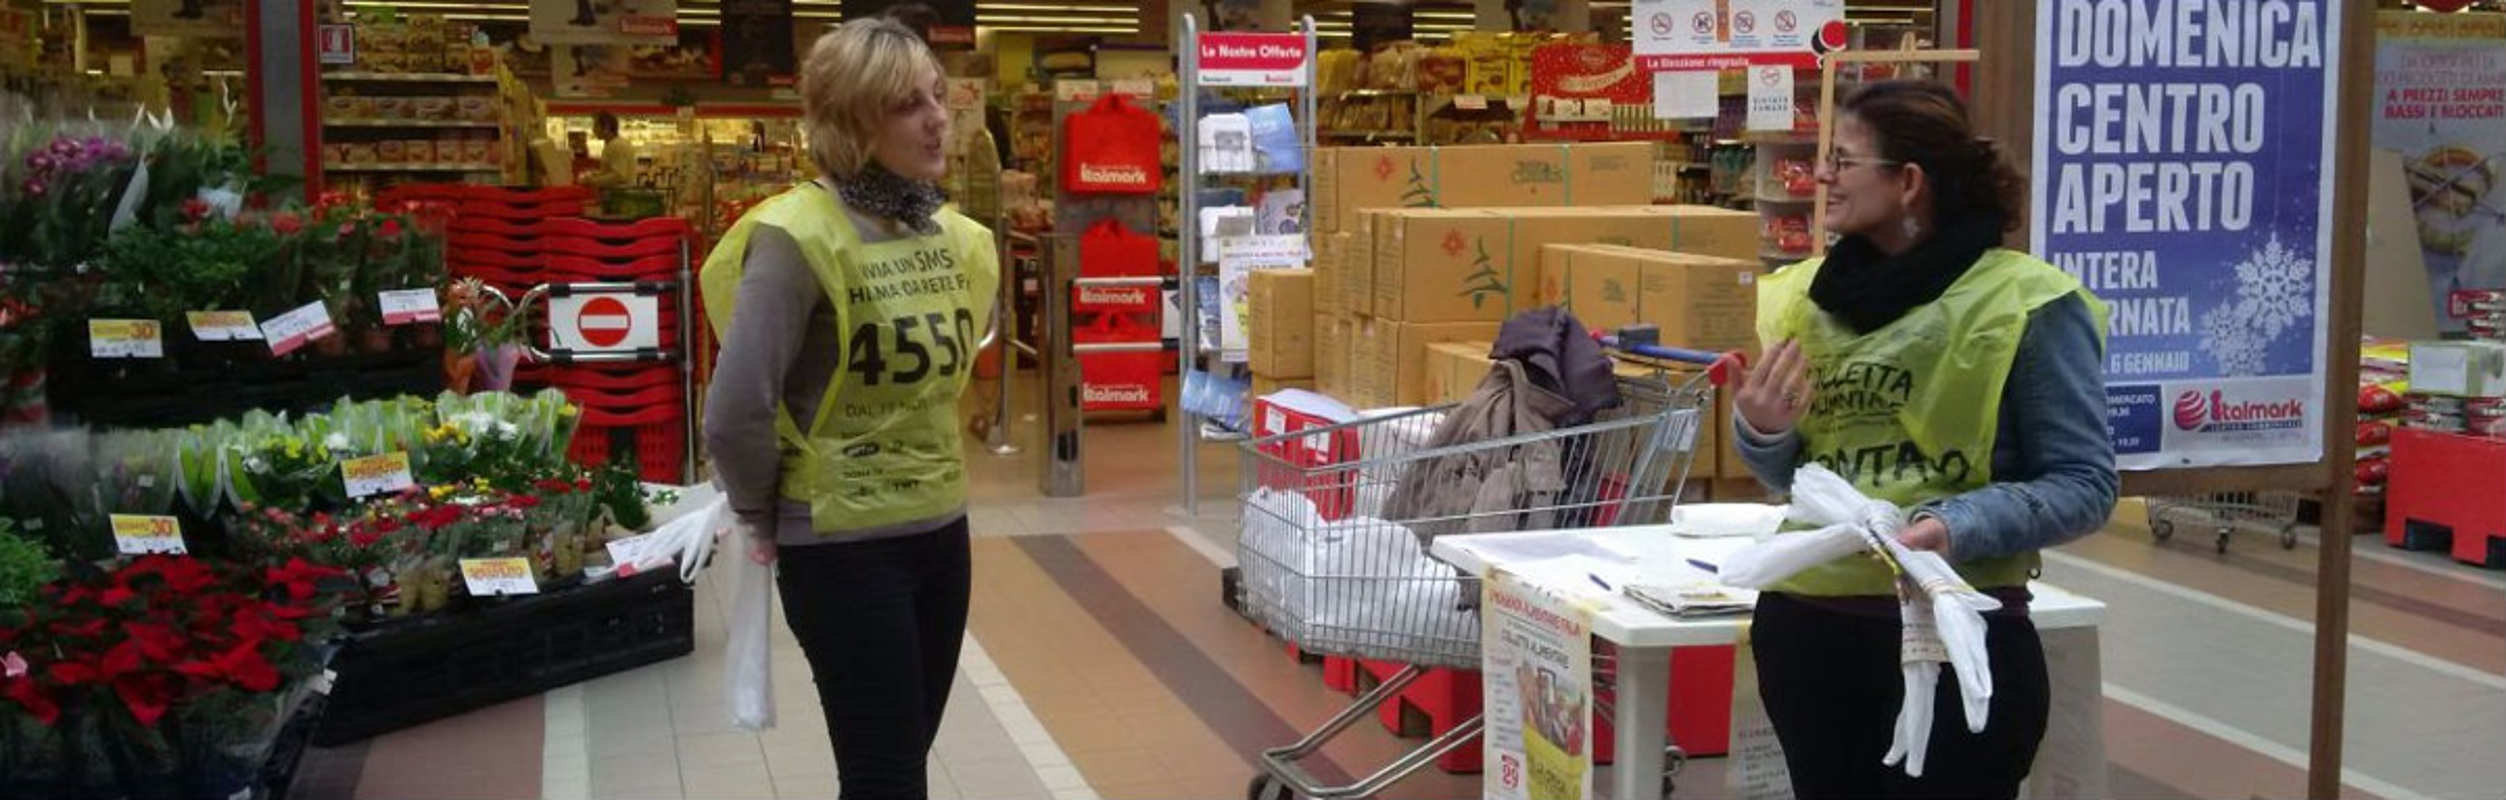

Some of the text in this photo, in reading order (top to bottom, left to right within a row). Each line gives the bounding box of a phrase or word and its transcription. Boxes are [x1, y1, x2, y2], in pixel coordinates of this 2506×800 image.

[2059, 0, 2321, 68] DOMENICA
[1202, 44, 1302, 57] Le Nostre Offerte
[2387, 88, 2504, 102] A PREZZI SEMPRE
[2056, 82, 2265, 155] CENTRO
[2384, 104, 2426, 118] BASSI
[2053, 161, 2255, 234] APERTO
[916, 249, 955, 273] SMS
[2123, 351, 2189, 374] GENNAIO
